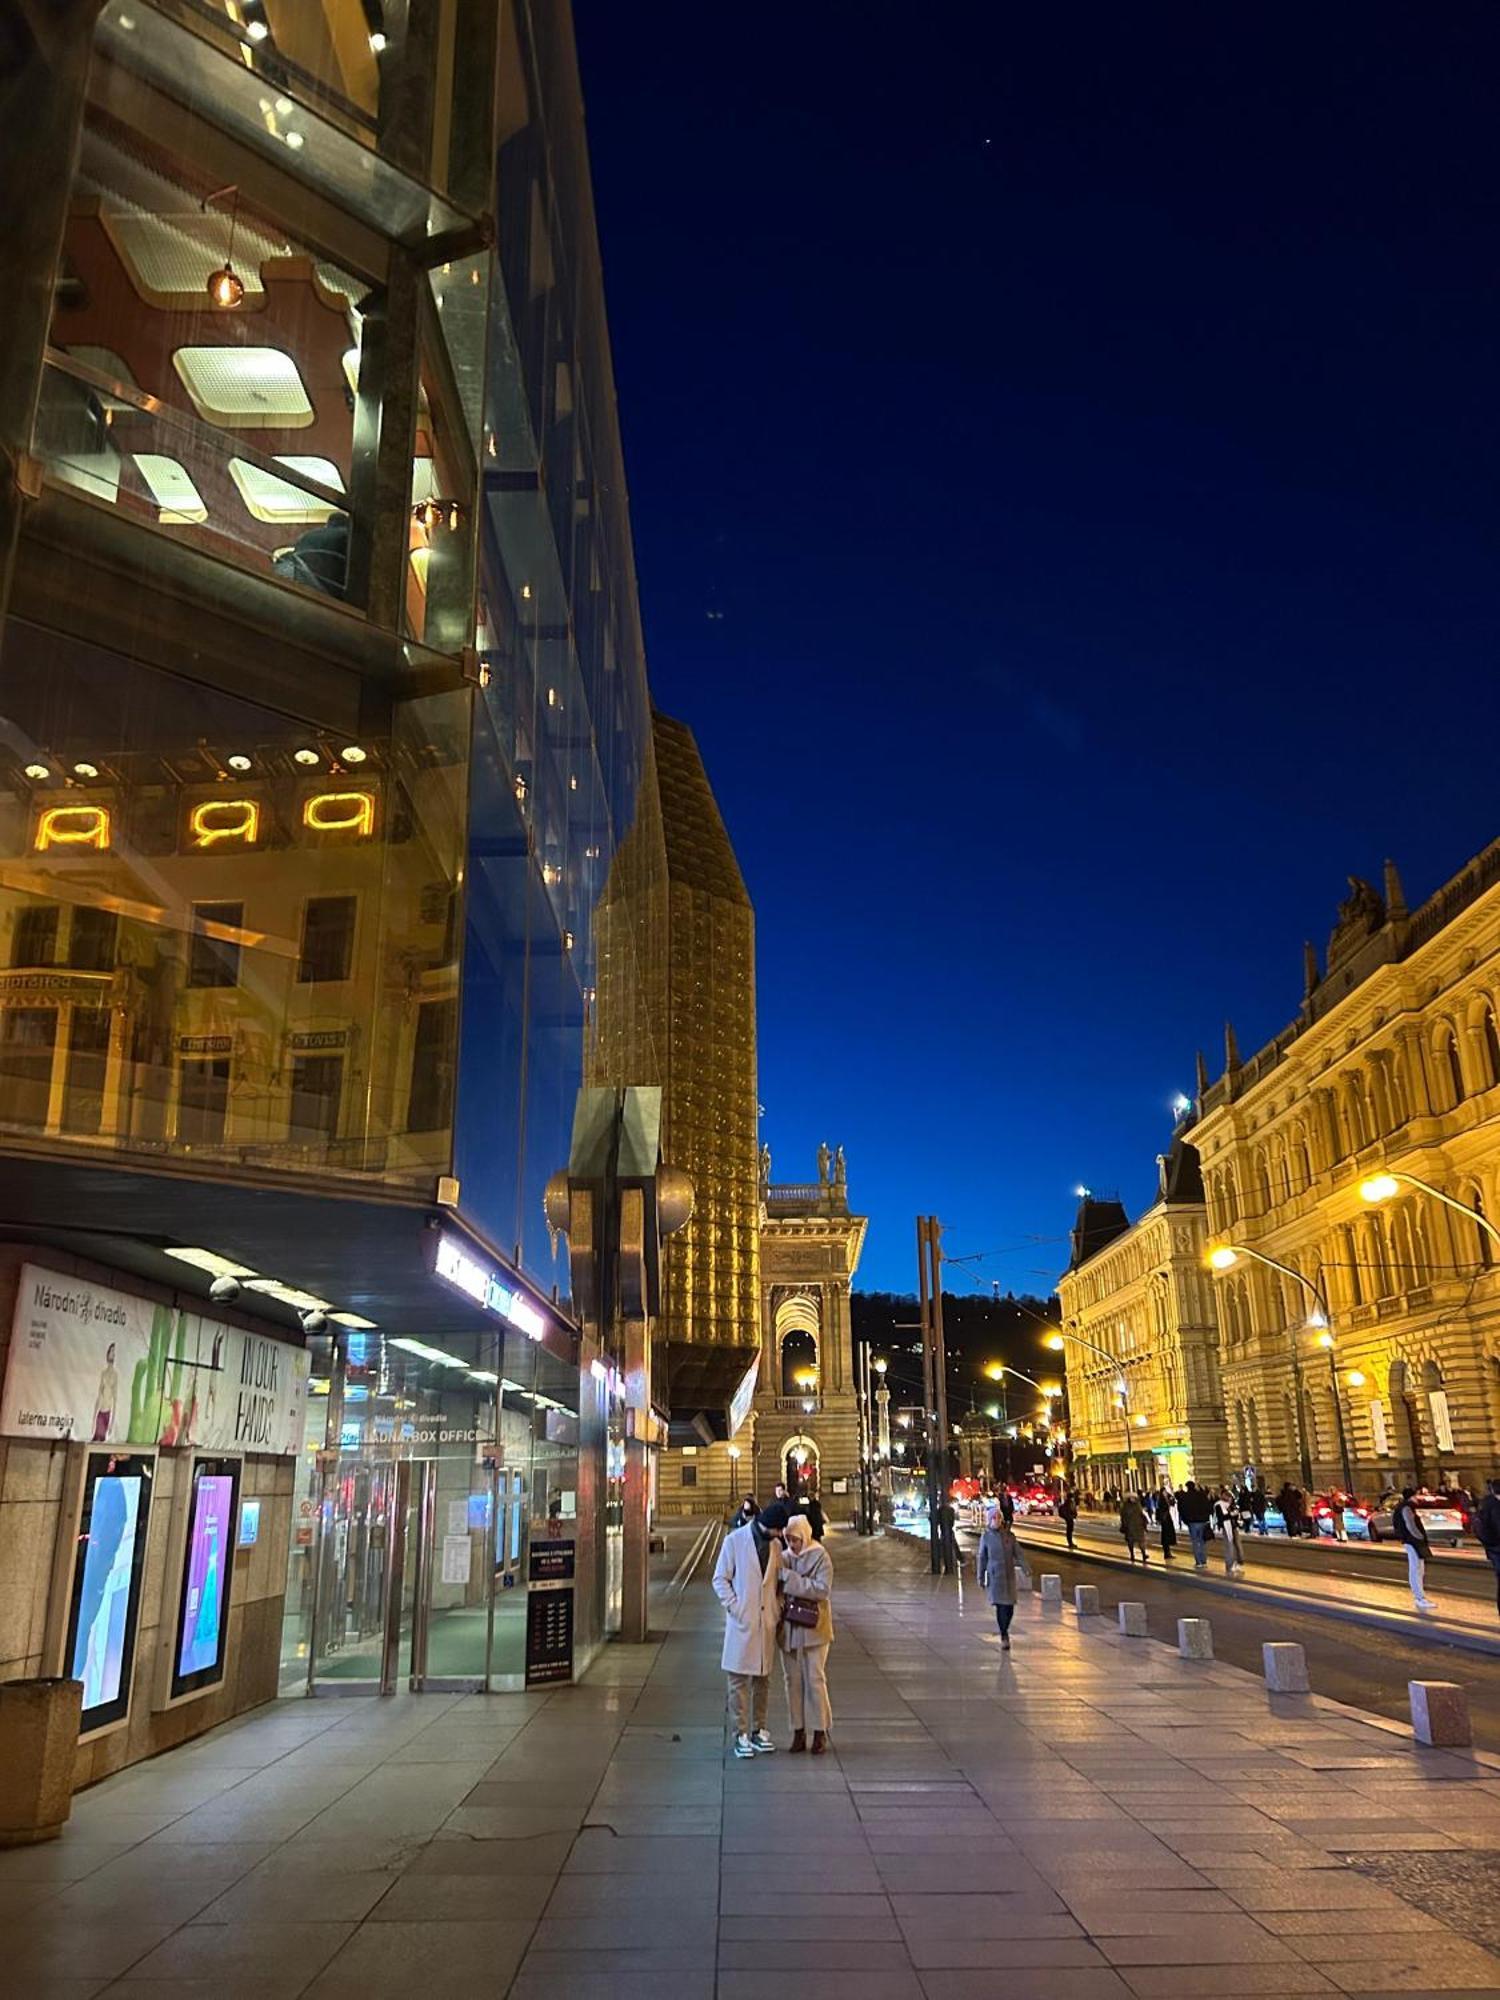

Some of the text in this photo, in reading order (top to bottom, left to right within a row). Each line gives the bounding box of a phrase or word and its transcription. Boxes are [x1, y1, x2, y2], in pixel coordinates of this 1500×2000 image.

[33, 1284, 126, 1326] Národní divadlo
[240, 1335, 278, 1393] IN OUR
[235, 1391, 274, 1444] HANDS
[439, 1430, 480, 1442] OFFIC
